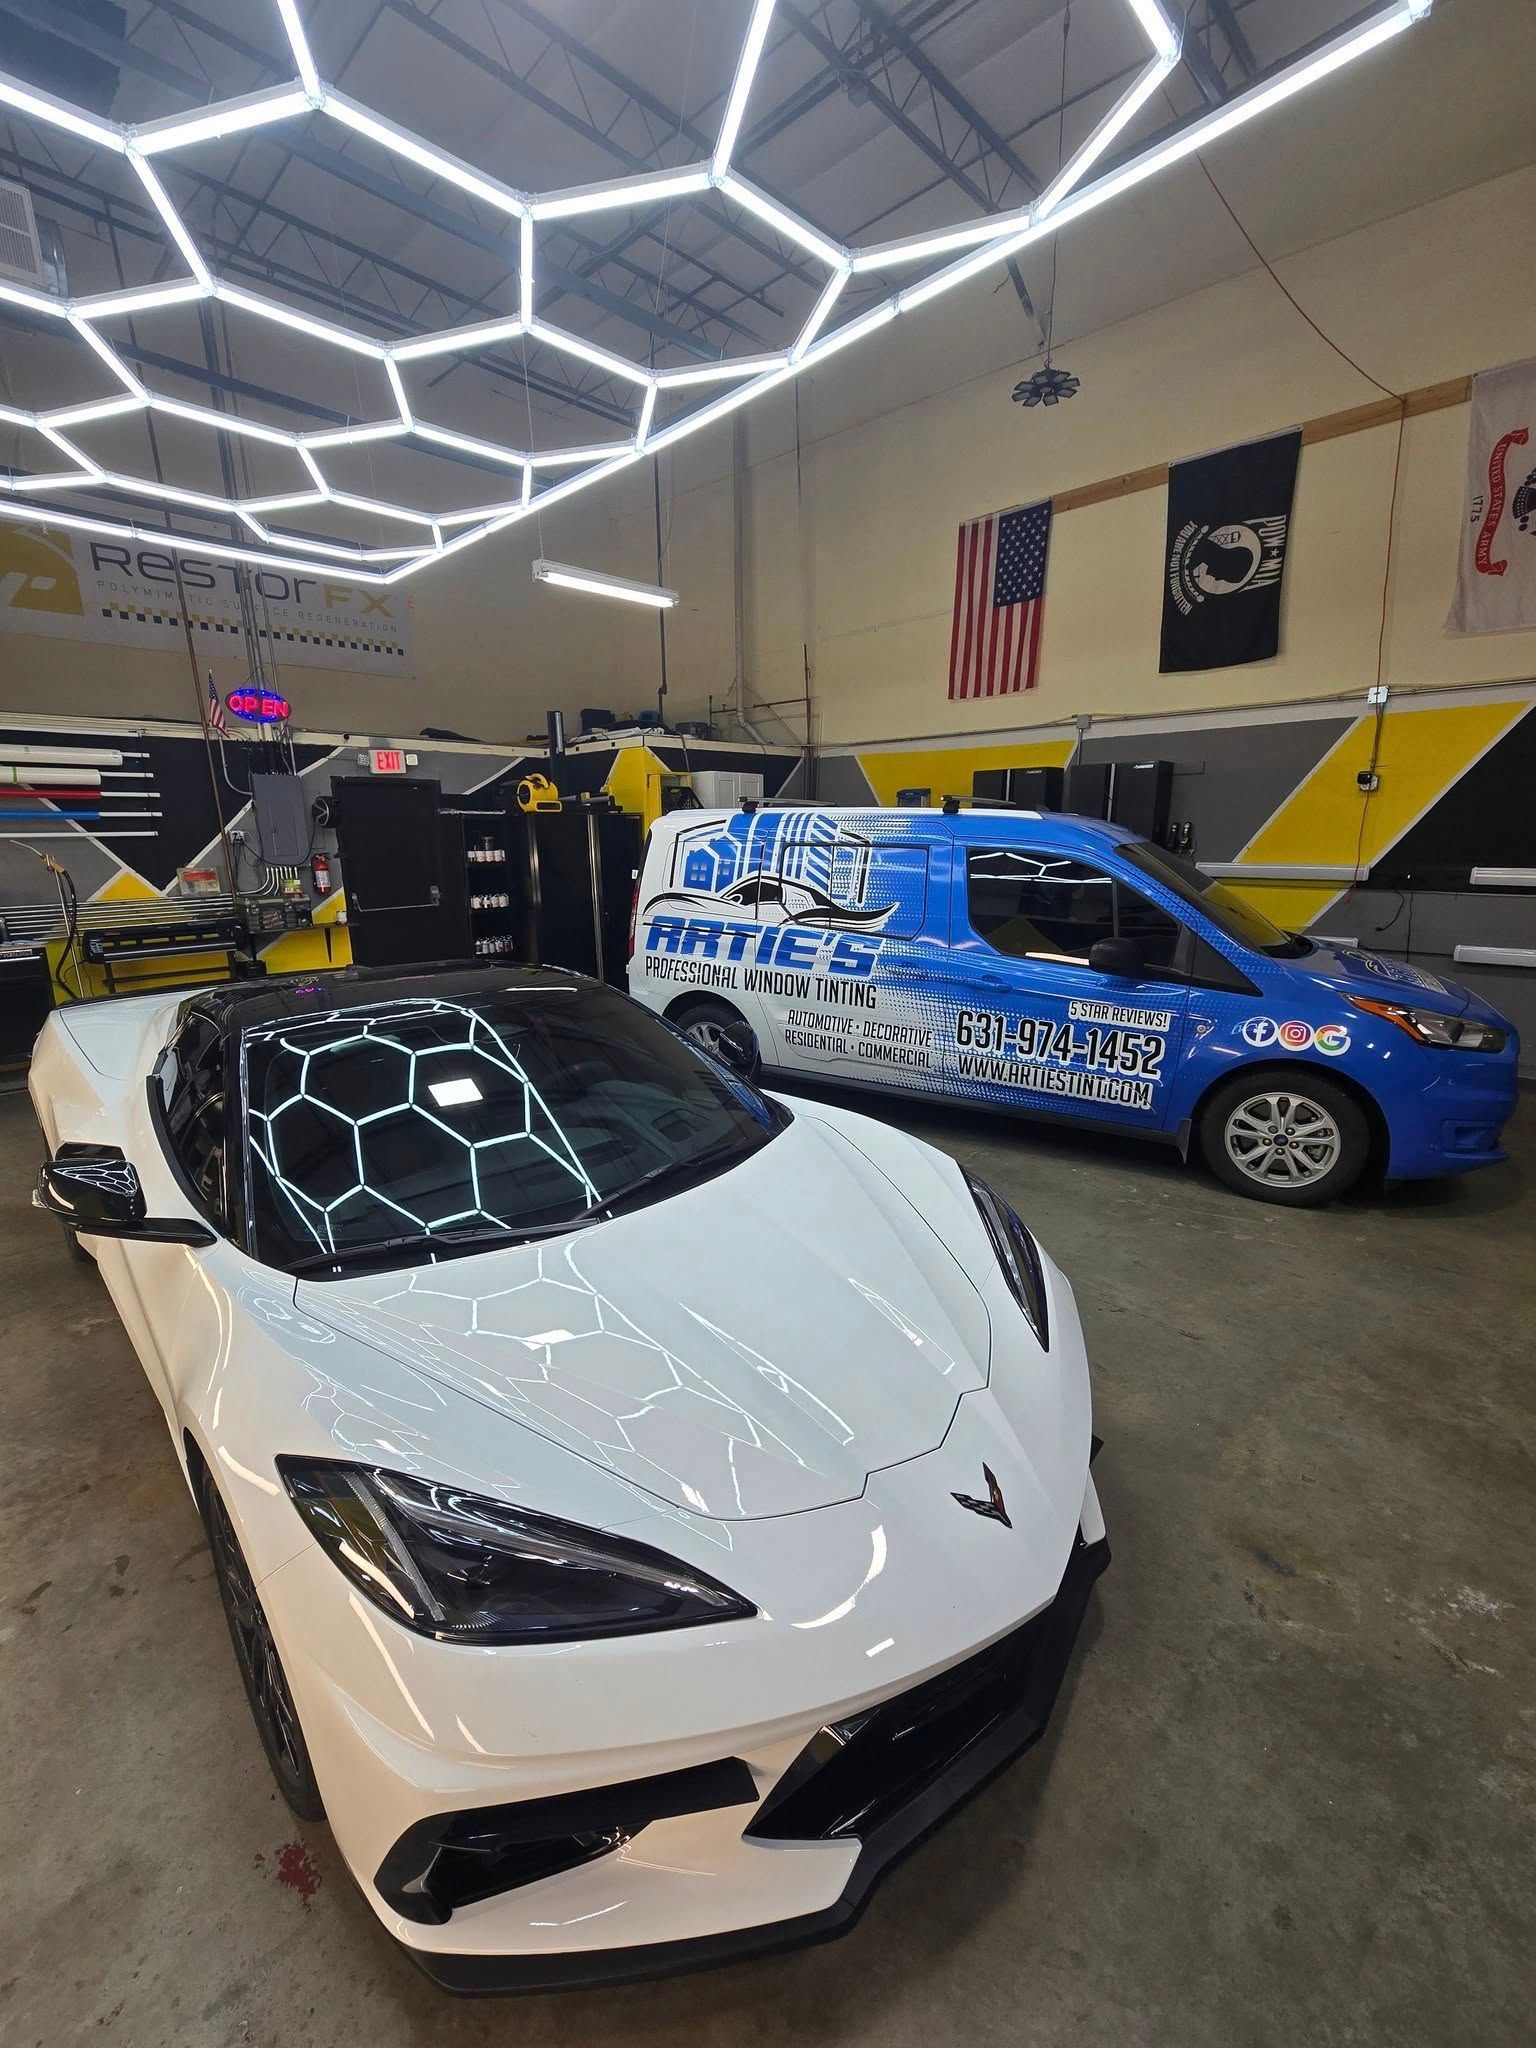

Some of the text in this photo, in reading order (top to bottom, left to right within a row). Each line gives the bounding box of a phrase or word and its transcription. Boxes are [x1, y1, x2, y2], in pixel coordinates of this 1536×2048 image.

[1470, 495, 1484, 523] 1775
[1478, 443, 1507, 564] UNITED STATES ARMY
[1169, 520, 1198, 616] YOU ARE NOT FORGOTTEN
[1241, 514, 1287, 592] POW MIA
[97, 580, 213, 606] POLYMIMTIC
[298, 611, 398, 633] REGENERATION
[228, 695, 289, 718] OPEN
[376, 751, 401, 771] EXIT
[645, 915, 885, 978] ARTIE'S
[645, 955, 877, 1010] PROFESSIONAL WINDOW TINTING
[787, 1009, 932, 1048] AUTOMOTIVE DECORATIVE
[1070, 1002, 1168, 1028] 5 STAR REVIEWS!
[785, 1028, 932, 1069] RESIDENTIAL COMMERCIAL
[956, 1010, 1164, 1076] 631-974-1452
[958, 1054, 1151, 1106] WWW.ARTIESTINT.COM
